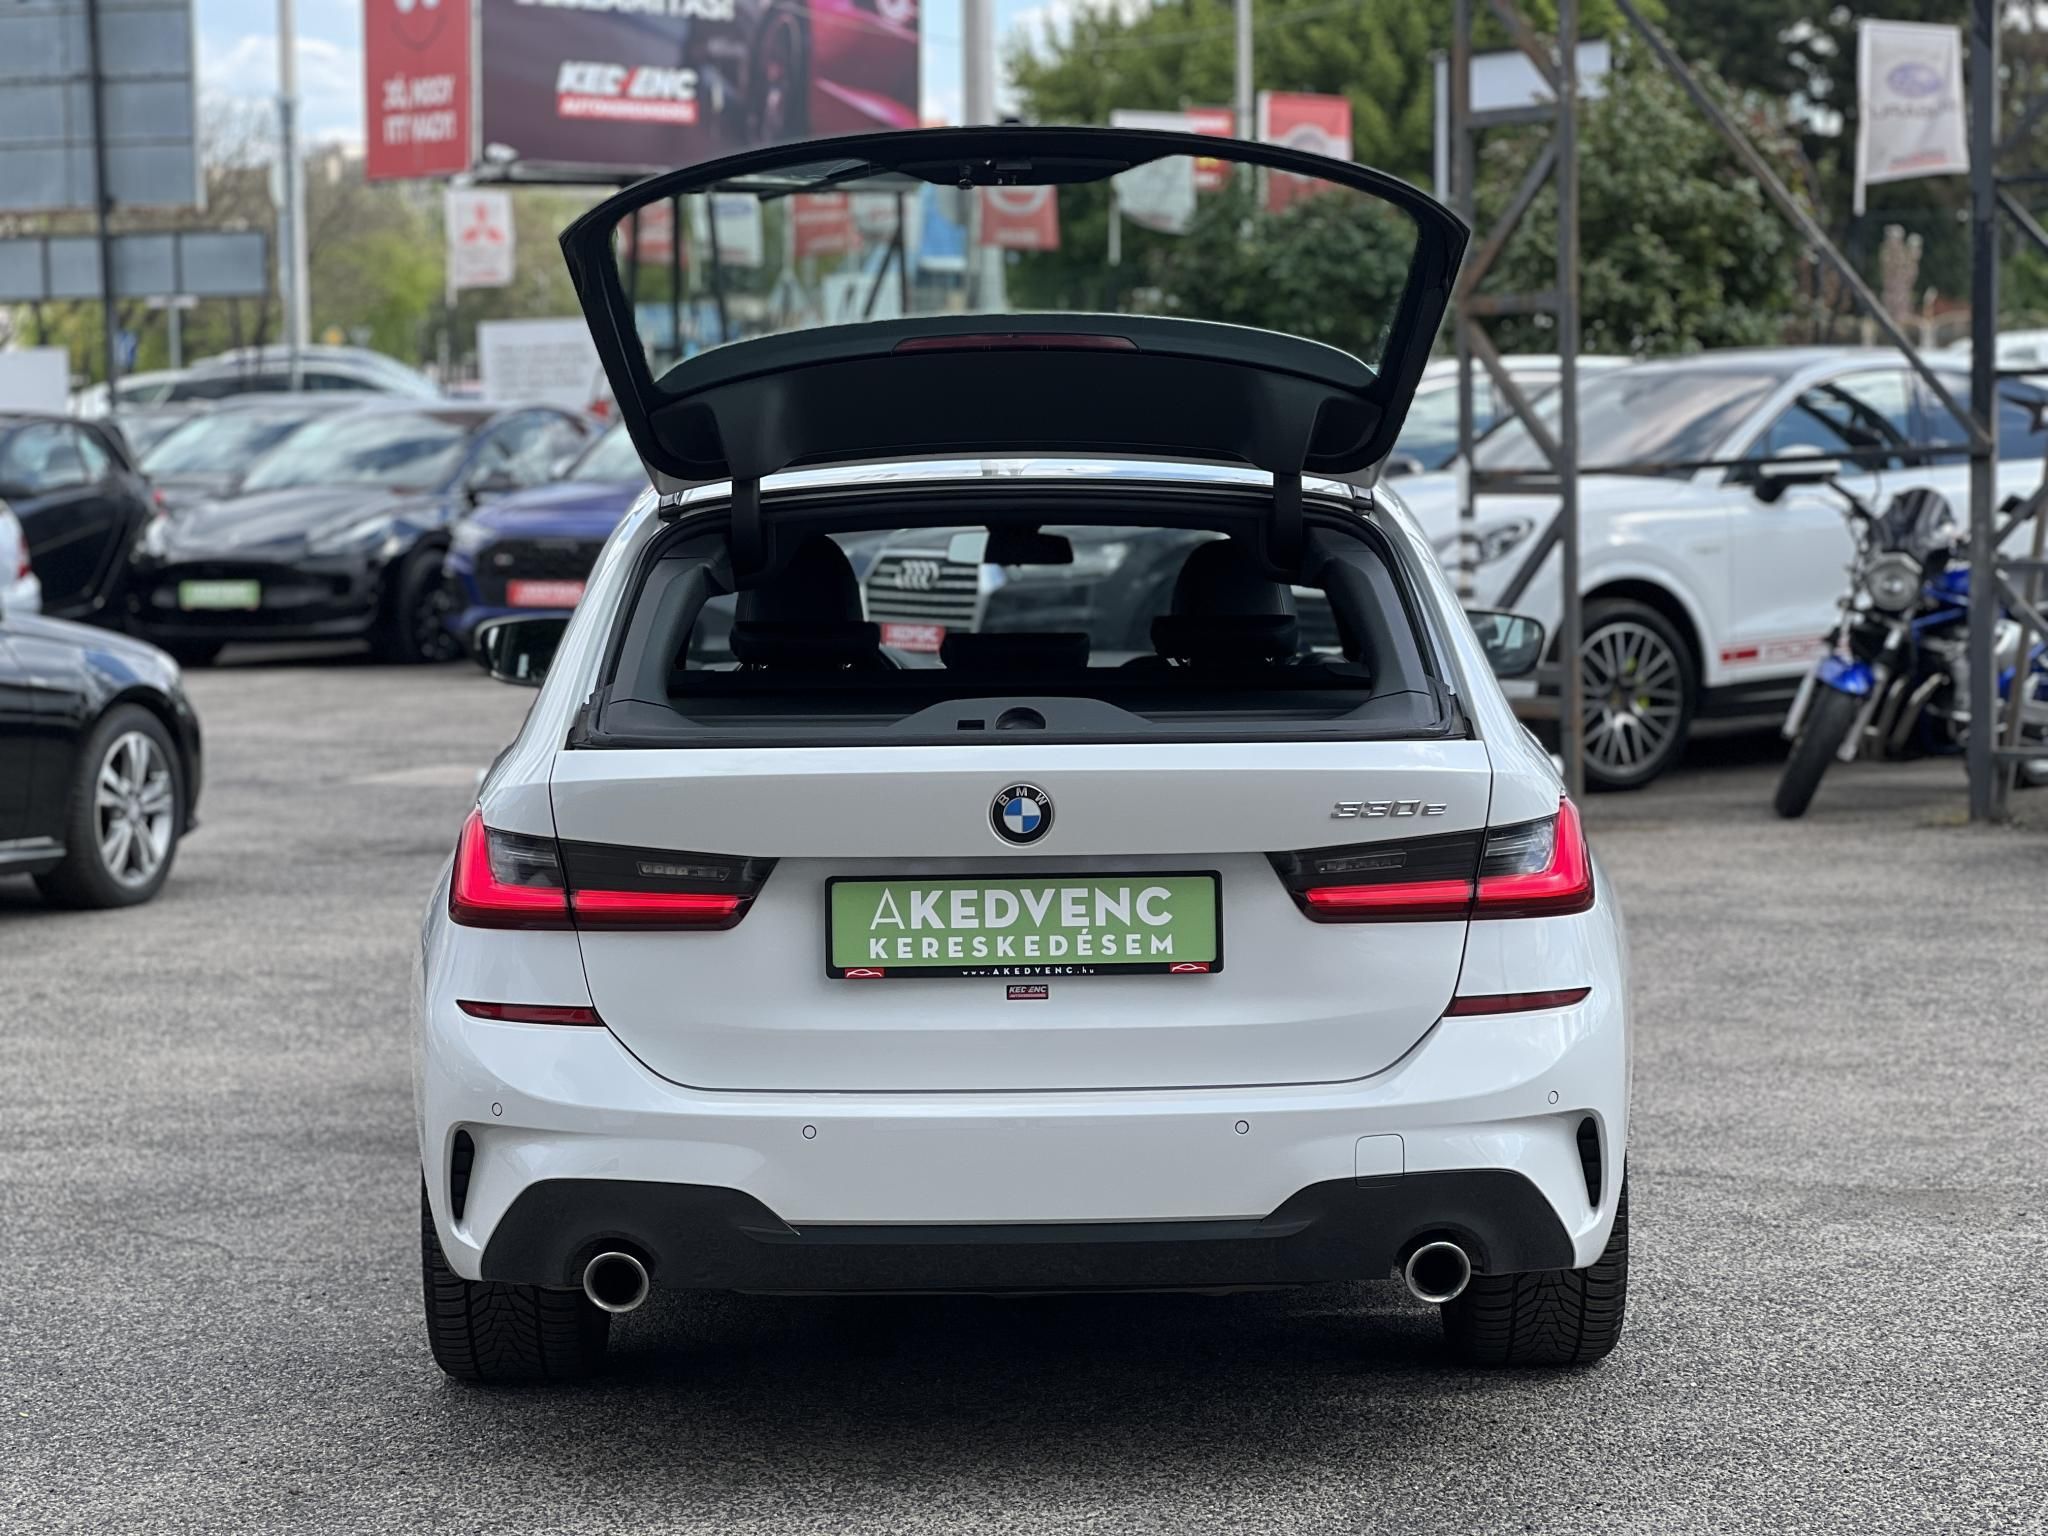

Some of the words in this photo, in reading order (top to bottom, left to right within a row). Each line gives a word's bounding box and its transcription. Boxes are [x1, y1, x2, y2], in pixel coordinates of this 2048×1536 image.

[997, 787, 1048, 807] BMW
[1331, 799, 1447, 819] 330e
[869, 886, 1174, 930] AKEDVENC
[869, 930, 1174, 960] KERESKEDÉSEM
